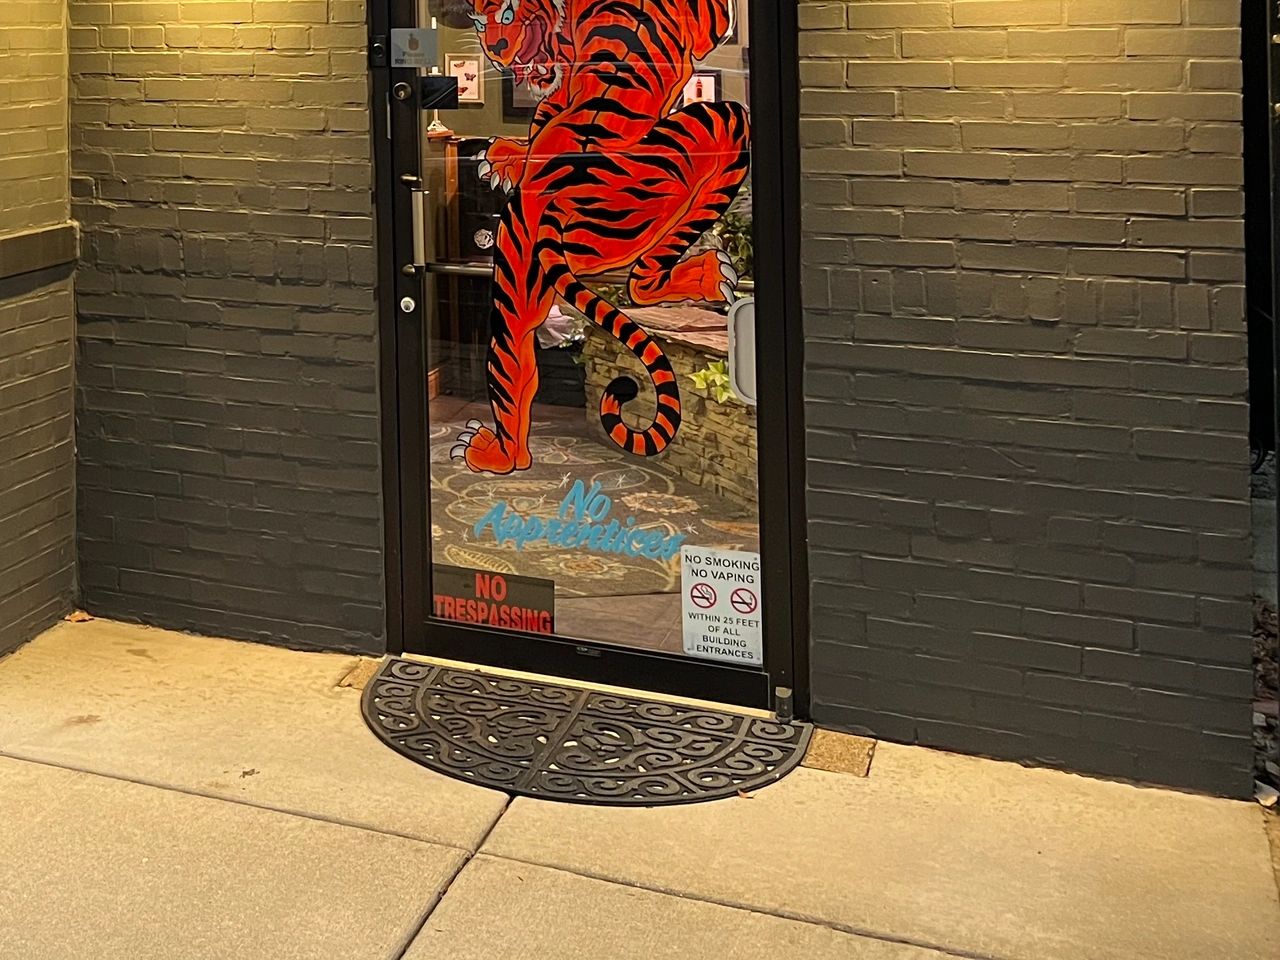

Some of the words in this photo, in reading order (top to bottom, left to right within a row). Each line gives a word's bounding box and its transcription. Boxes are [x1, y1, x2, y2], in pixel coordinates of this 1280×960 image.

[559, 479, 612, 522] No
[473, 500, 687, 560] Apprentices
[685, 554, 702, 565] NO
[705, 556, 760, 571] SMOKING
[691, 569, 708, 578] NO
[711, 570, 755, 584] VAPING
[475, 573, 508, 602] NO
[433, 595, 552, 635] TRESPASSING
[688, 612, 720, 623] WITHIN
[723, 617, 734, 625] 25
[736, 619, 760, 628] FEET
[708, 625, 720, 633] OF
[723, 627, 741, 637] ALL
[702, 635, 747, 648] BUILDING
[696, 644, 754, 659] ENTRANCES
